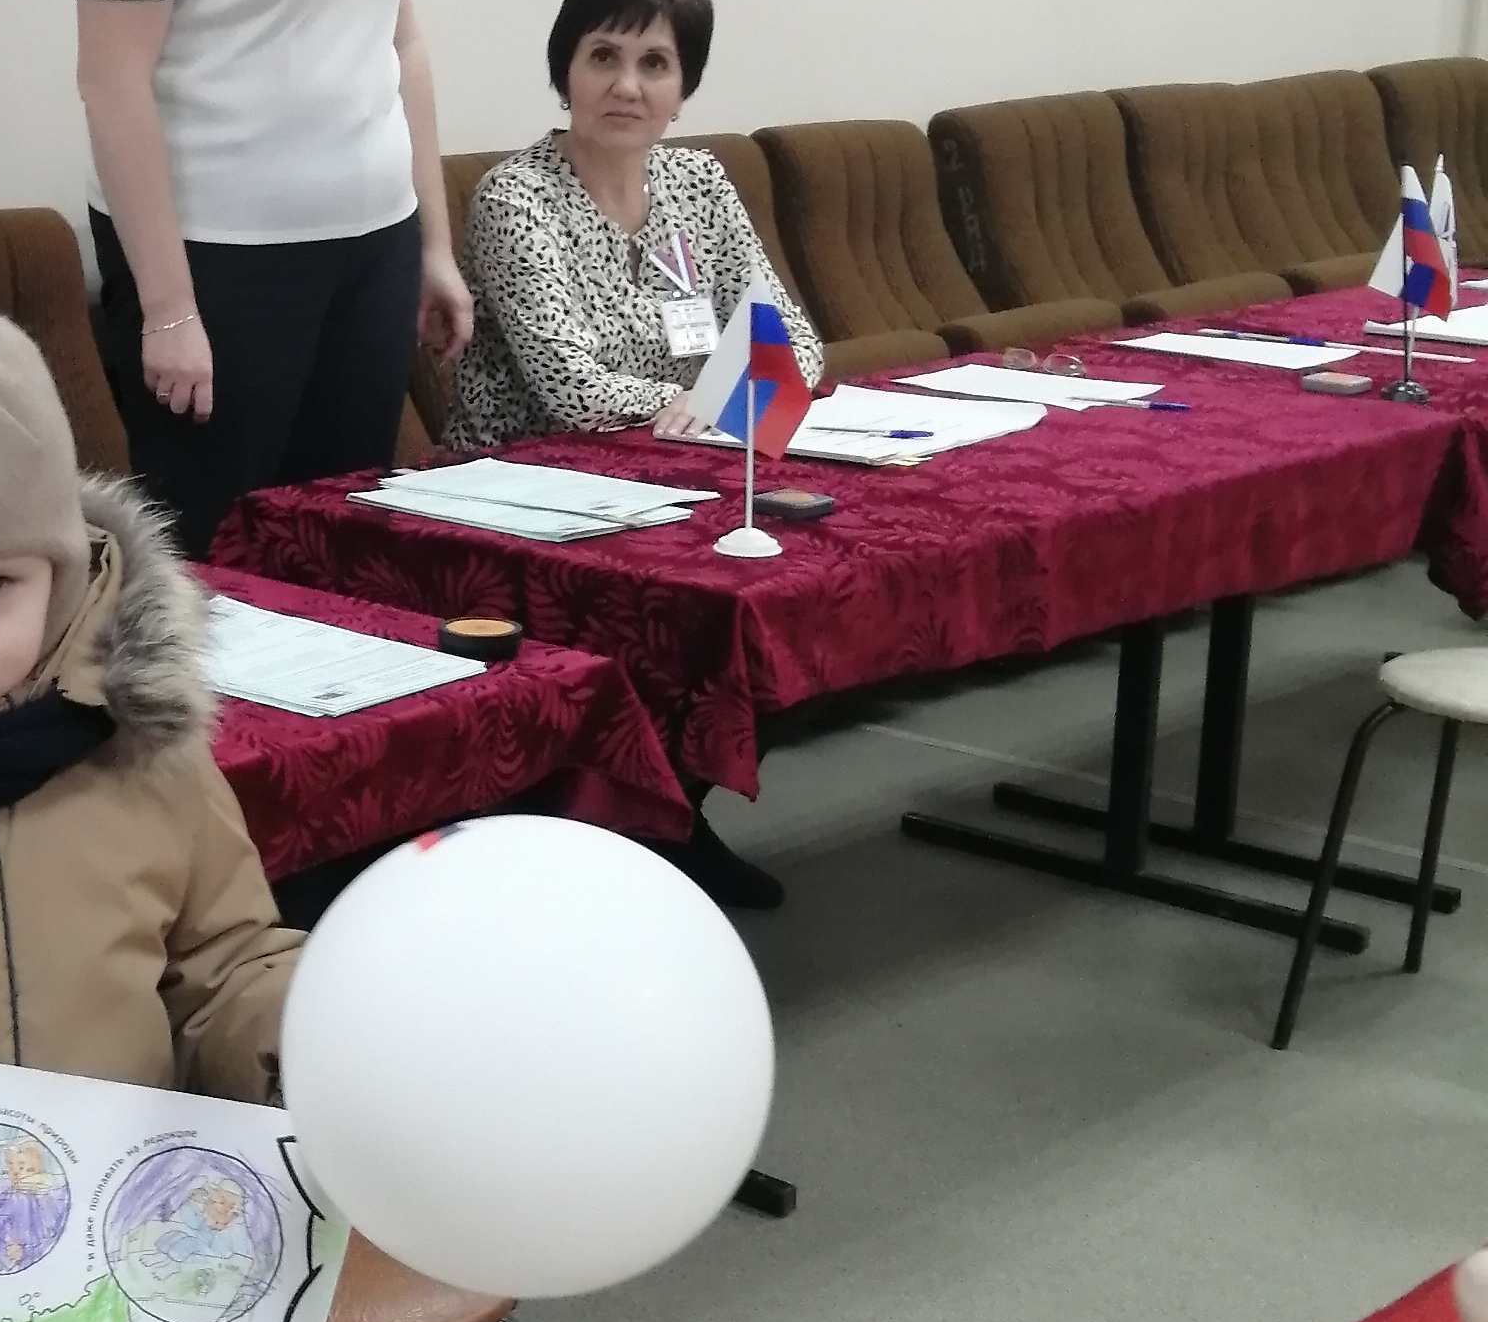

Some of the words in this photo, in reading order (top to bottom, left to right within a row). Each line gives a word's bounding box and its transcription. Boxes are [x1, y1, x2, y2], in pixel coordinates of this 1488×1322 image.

[39, 1122, 79, 1165] природы
[90, 1158, 125, 1212] поплавать
[126, 1145, 140, 1157] на
